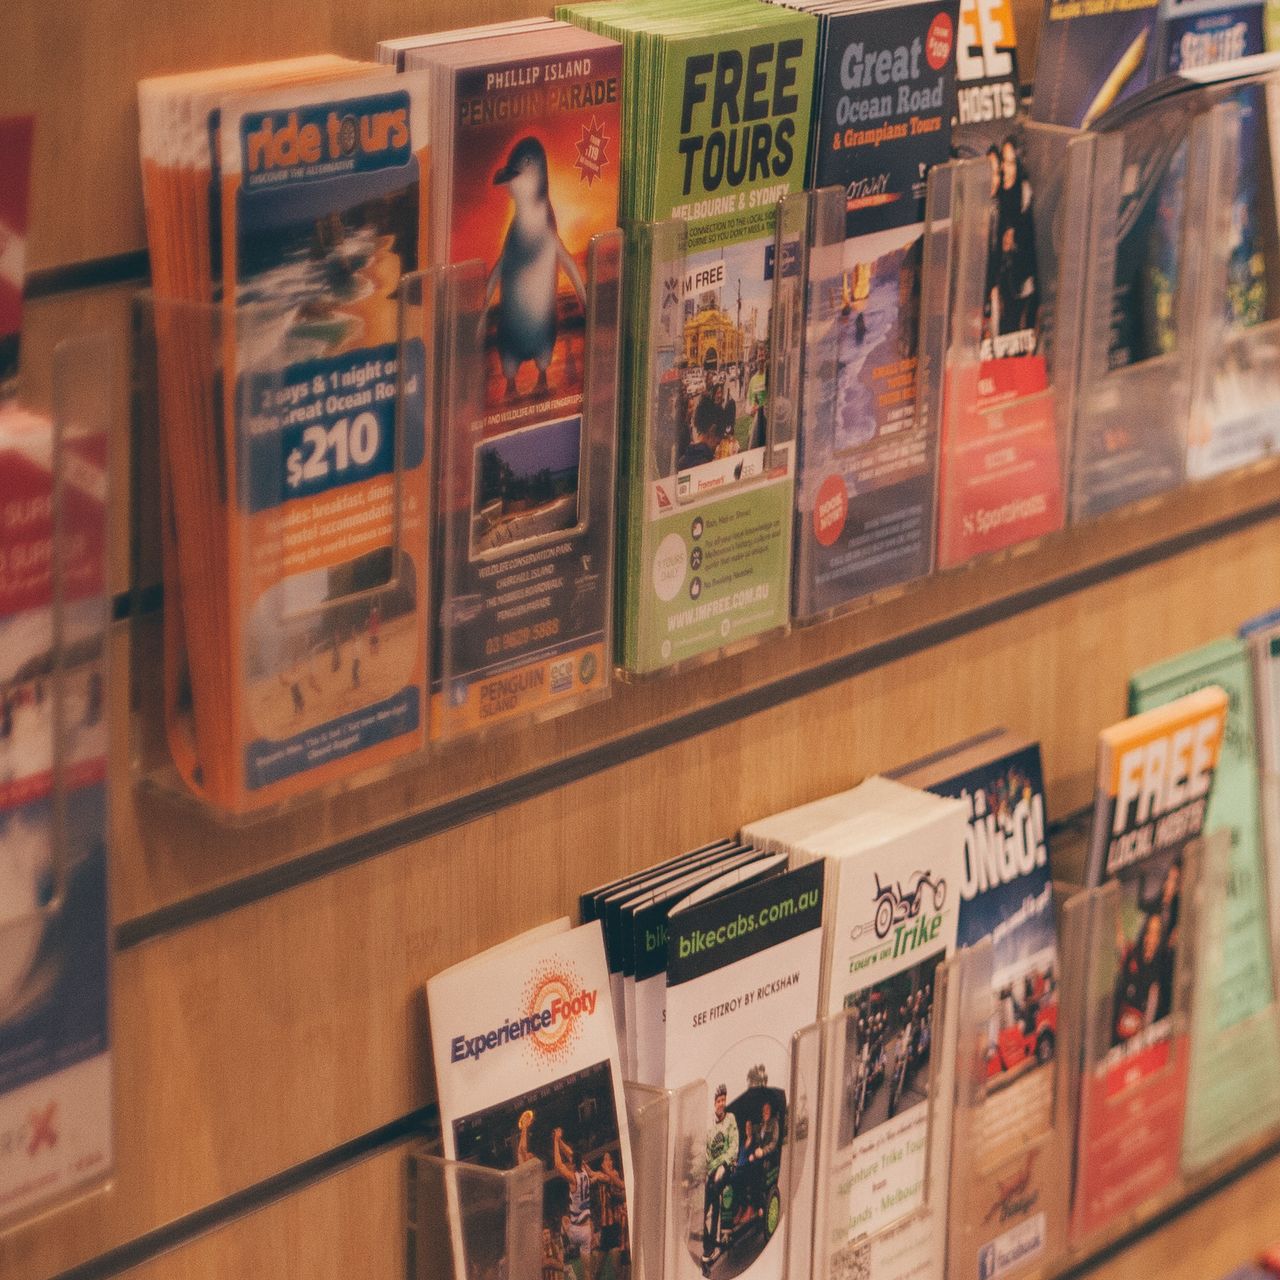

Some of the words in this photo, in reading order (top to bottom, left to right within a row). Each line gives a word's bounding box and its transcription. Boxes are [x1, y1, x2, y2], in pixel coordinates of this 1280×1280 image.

[487, 66, 540, 90] PHILLIP
[544, 59, 592, 81] ISLAND
[681, 38, 803, 134] FREE
[840, 36, 922, 89] Great
[549, 77, 617, 112] PARADE
[836, 95, 895, 126] Ocean
[897, 77, 944, 115] Road
[248, 112, 322, 173] ride
[327, 108, 409, 159] tours
[679, 118, 796, 196] TOURS
[833, 132, 841, 149] &
[844, 121, 907, 147] Grampians
[909, 116, 942, 136] Tours
[671, 195, 736, 220] MELBOURNE
[738, 192, 746, 211] &
[748, 183, 790, 209] SYDNEY
[695, 265, 724, 289] FREE
[341, 360, 382, 388] night
[326, 389, 372, 414] Ocean
[286, 411, 380, 489] $210
[1112, 716, 1218, 836] FREE
[679, 888, 819, 959] bikecabs.com.au
[893, 914, 943, 959] Trike
[692, 1012, 708, 1028] SEE
[709, 996, 743, 1021] FITZROY
[744, 991, 755, 1007] BY
[756, 972, 801, 1002] RICKSHAW
